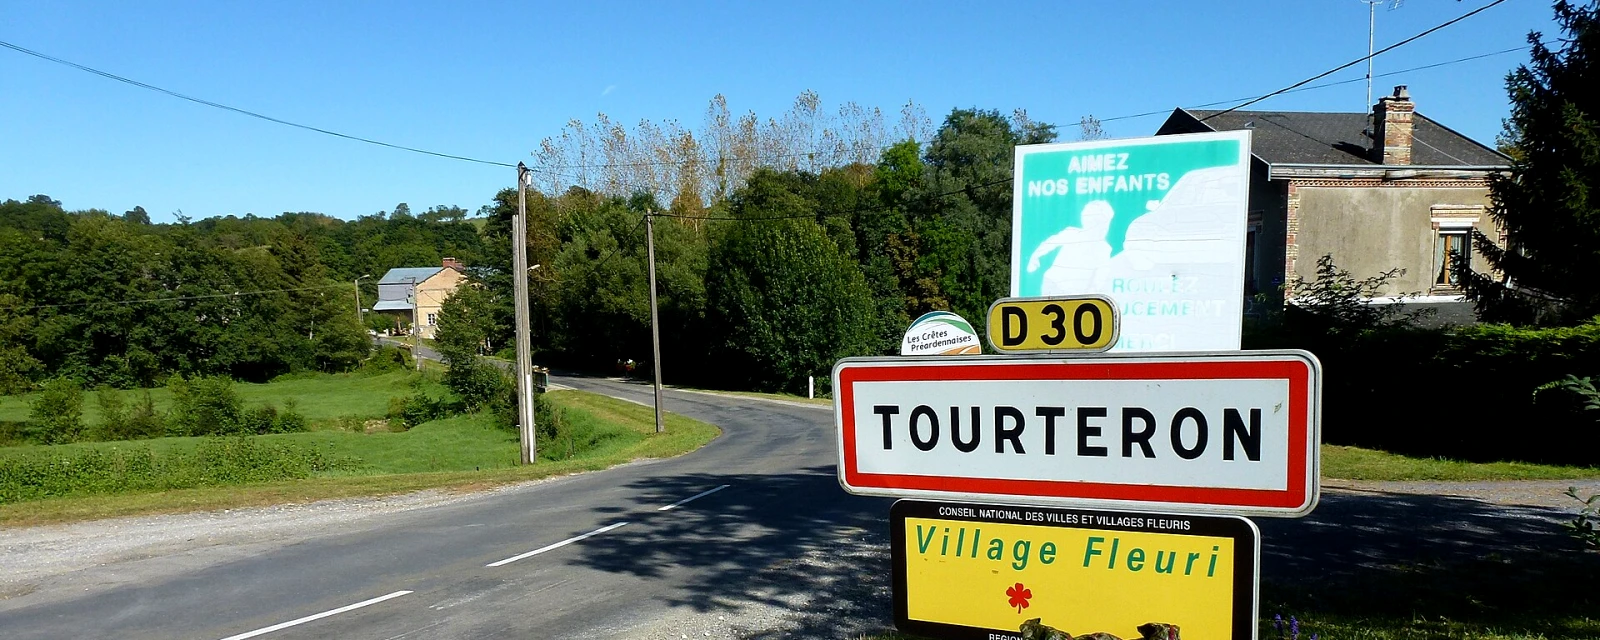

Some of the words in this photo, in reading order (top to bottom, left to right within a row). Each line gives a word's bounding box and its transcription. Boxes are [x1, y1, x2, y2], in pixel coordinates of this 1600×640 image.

[1067, 153, 1130, 174] AIMEZ
[1028, 178, 1069, 198] NOS
[1075, 172, 1171, 195] ENFANTS
[1112, 276, 1199, 293] ROULEZ
[907, 336, 920, 344] Les
[922, 330, 948, 341] Crêtes
[1001, 306, 1028, 347] D
[1040, 303, 1103, 346] 30
[911, 335, 972, 352] Préardennaises
[873, 404, 1263, 463] TOURTERON
[938, 506, 977, 518] CONSEIL
[979, 509, 1023, 521] NATIONAL
[1025, 511, 1044, 522] DES
[1046, 513, 1079, 524] VILLES
[1081, 515, 1094, 525] ET
[1096, 516, 1144, 528] VILLAGES
[1147, 518, 1191, 531] FLEURIS
[916, 524, 1058, 571] Village
[1083, 536, 1220, 578] Fleuri
